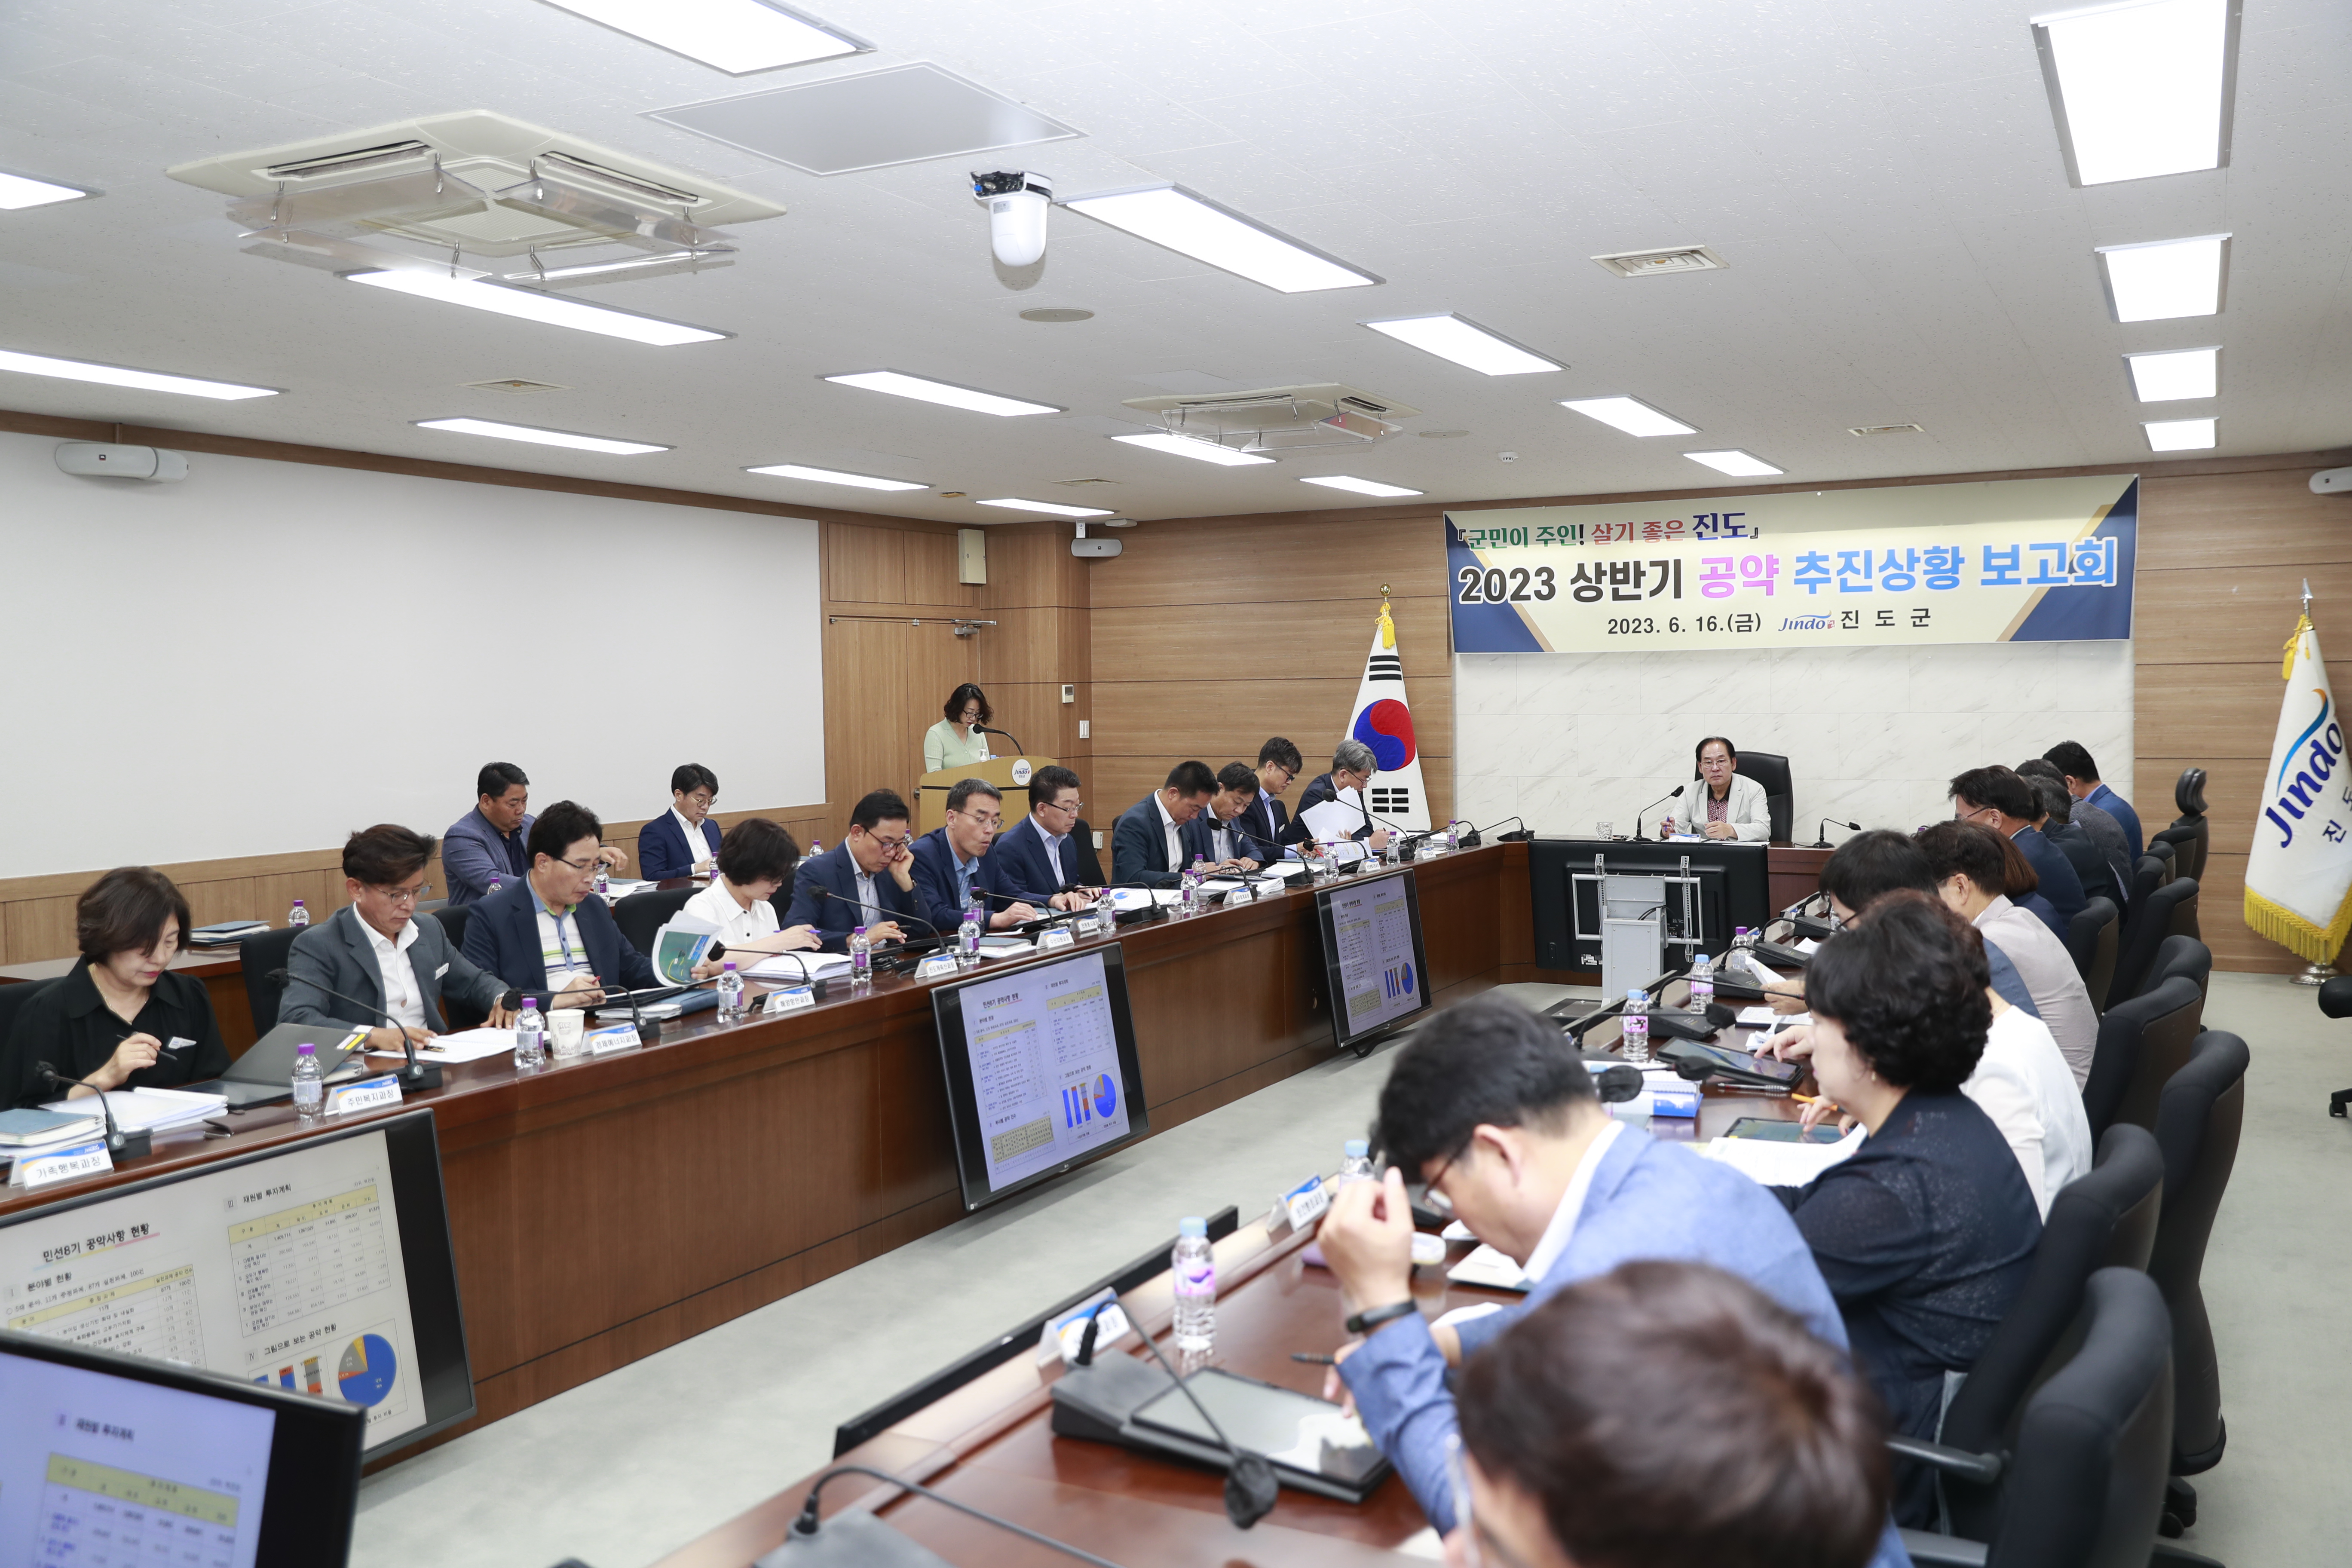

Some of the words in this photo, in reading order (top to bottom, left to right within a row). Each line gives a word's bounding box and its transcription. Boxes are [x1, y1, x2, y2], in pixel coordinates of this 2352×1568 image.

[1535, 524, 1585, 547] 주인!
[1591, 522, 1634, 545] 살기
[1642, 520, 1685, 543] 좋은
[1692, 513, 1759, 540] 진도』
[1460, 566, 1556, 603] 2023
[1570, 558, 1682, 603] 상반기
[1699, 554, 1779, 598] 공약
[1793, 545, 1966, 595] 추진상황
[1980, 539, 2114, 586] 보고회
[1608, 618, 1660, 635] 2023.
[1668, 617, 1686, 633] 6.
[1695, 612, 1762, 633] 16.(금)
[1778, 616, 1825, 632] Jindo
[2265, 723, 2342, 848] Jindo
[595, 1034, 637, 1049] 경제에너지과장
[347, 1089, 394, 1107] 주민복지과장
[36, 1155, 101, 1179] 가족행복과장
[243, 1192, 263, 1203] 재원별
[266, 1183, 292, 1197] 투자계획
[43, 1242, 81, 1263] 민선8기
[86, 1230, 126, 1251] 공약사항
[130, 1223, 150, 1238] 현황
[27, 1277, 52, 1292] 분야별
[56, 1271, 72, 1283] 현황
[264, 1340, 290, 1355] 그림으로
[293, 1335, 306, 1345] 보는
[309, 1328, 322, 1340] 공약
[324, 1323, 337, 1334] 현황
